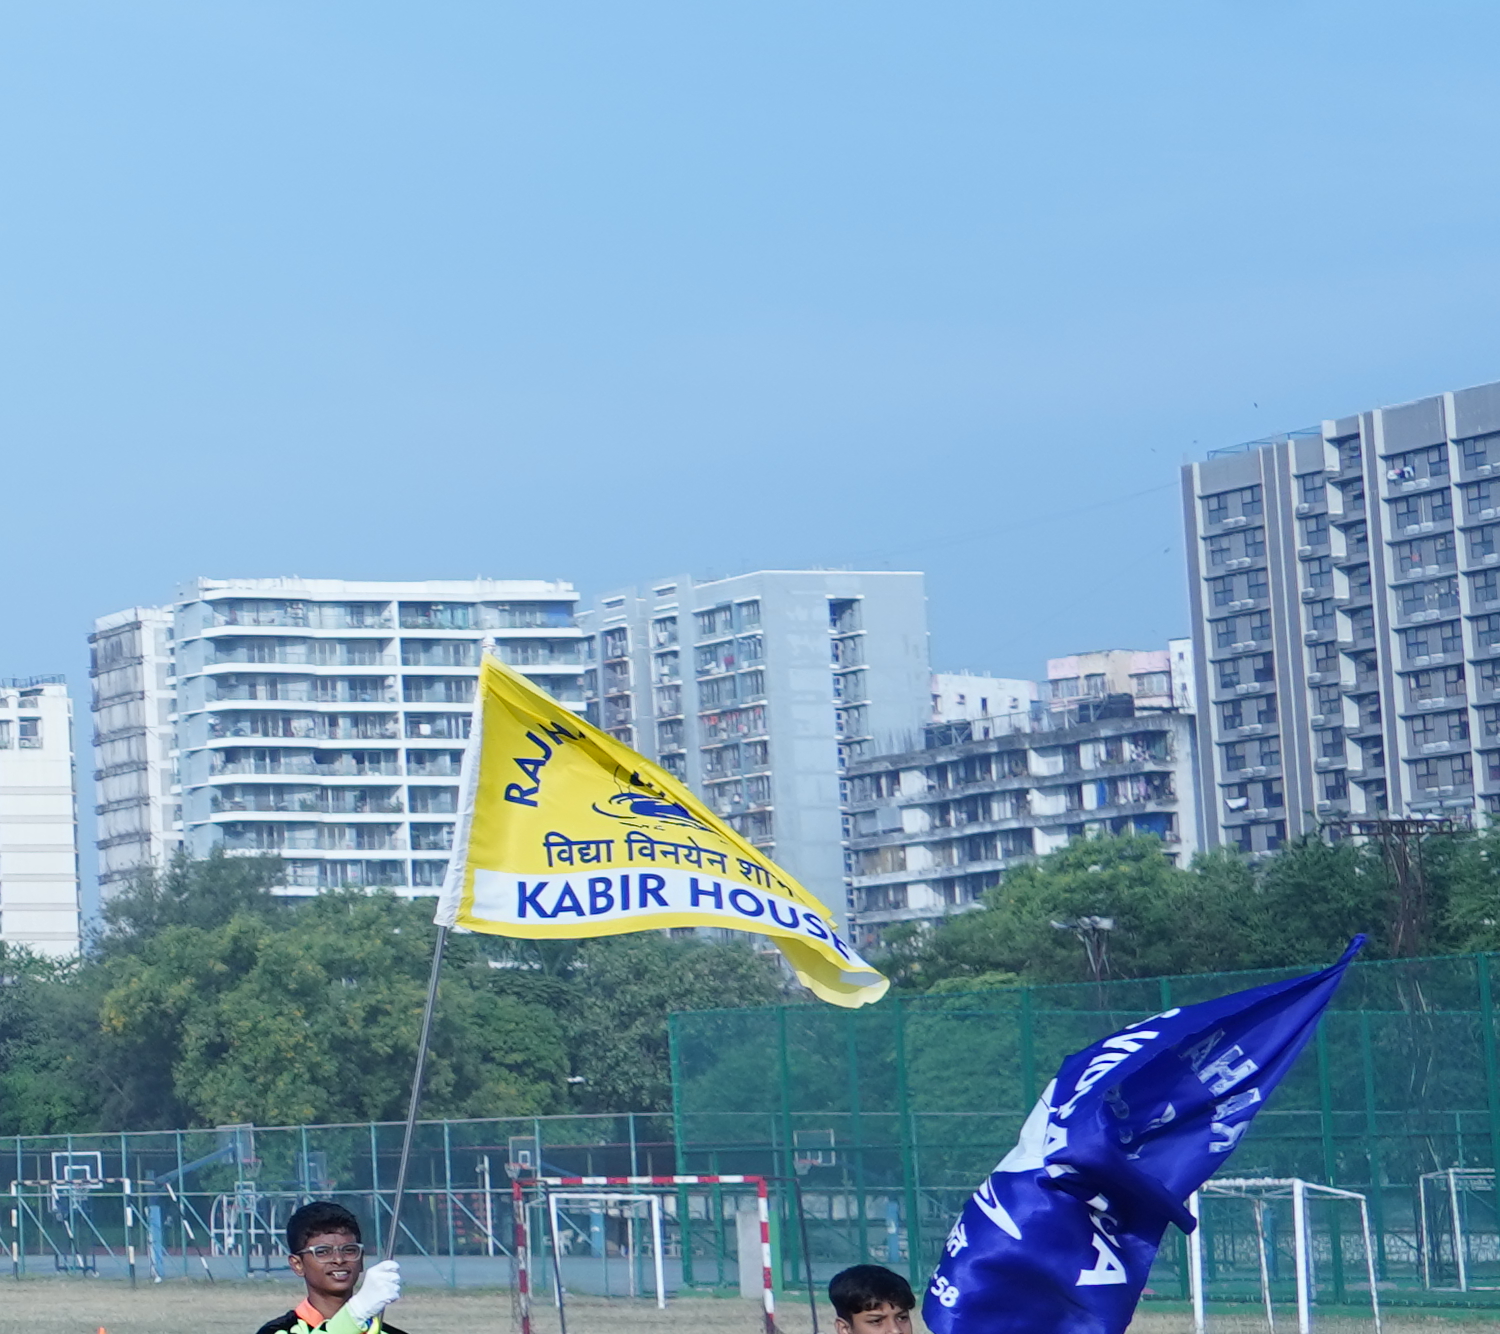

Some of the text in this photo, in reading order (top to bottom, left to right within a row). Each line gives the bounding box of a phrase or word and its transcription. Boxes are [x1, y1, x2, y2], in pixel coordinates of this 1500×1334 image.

[504, 721, 586, 807] RAJH
[542, 831, 614, 867] विद्या
[624, 830, 728, 874] विनयेन
[517, 873, 669, 919] KABIR
